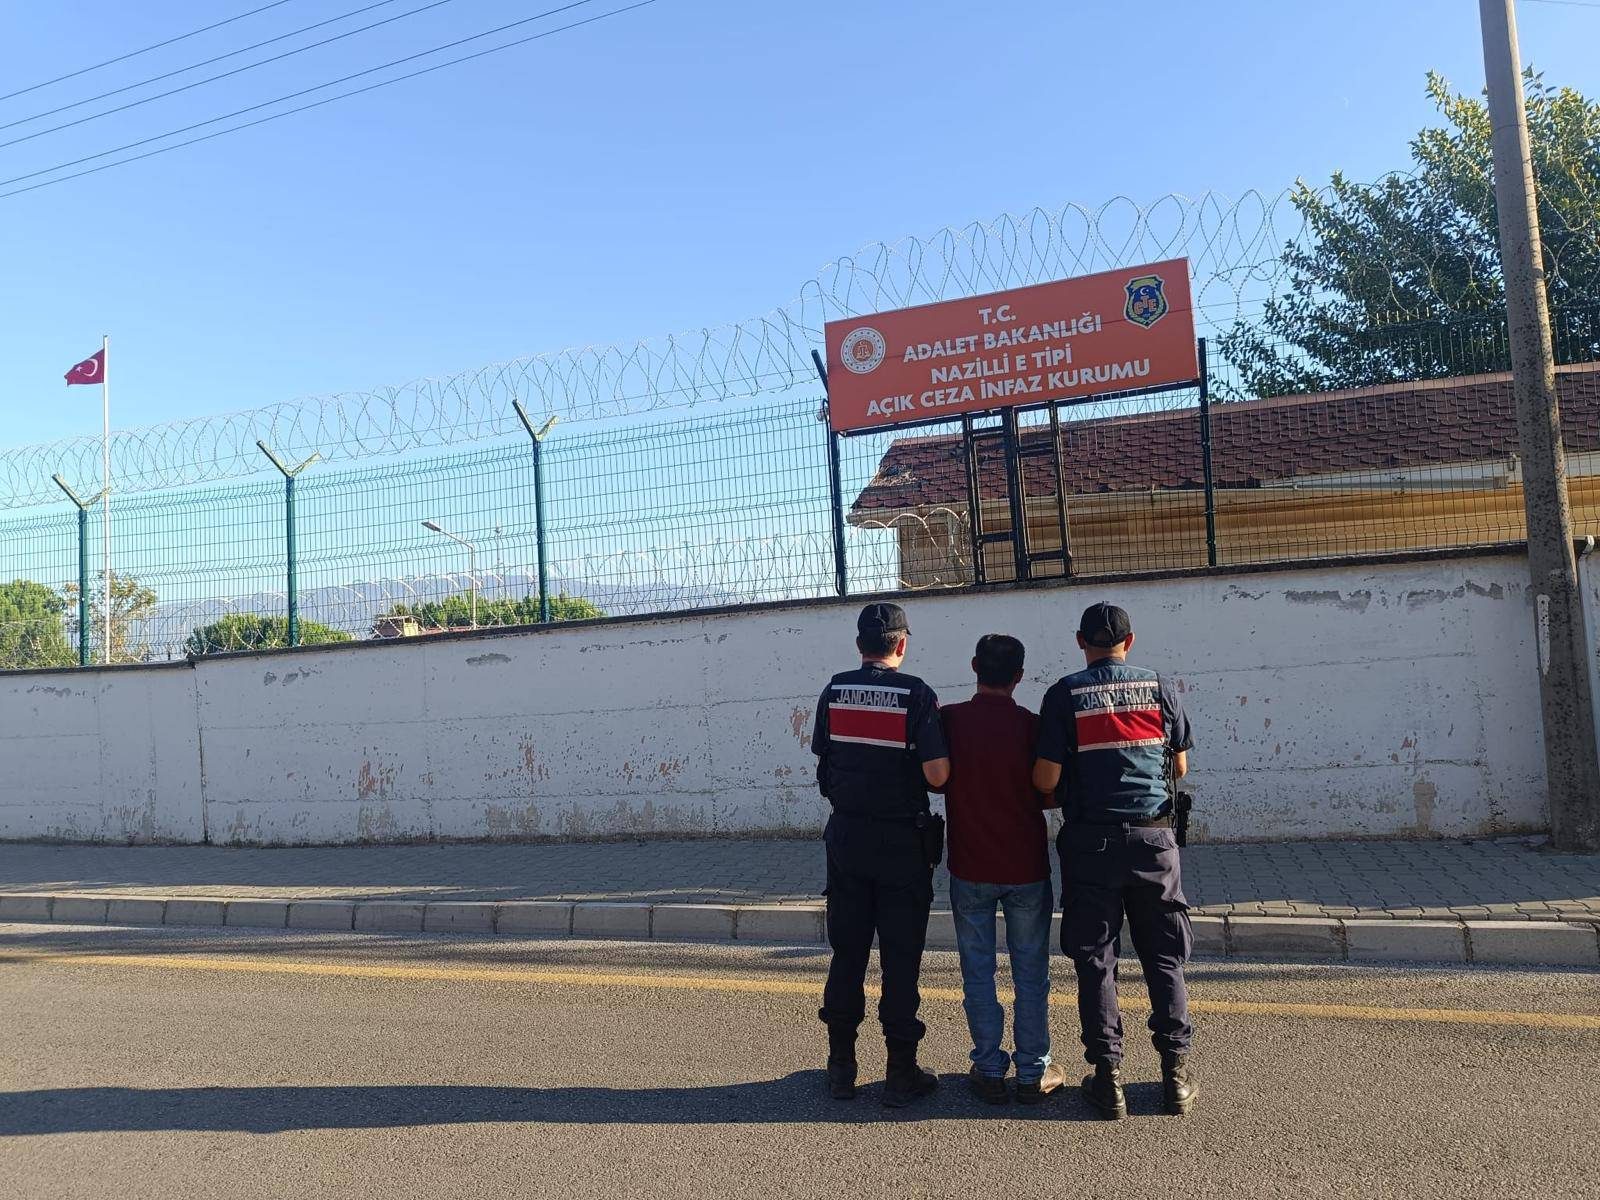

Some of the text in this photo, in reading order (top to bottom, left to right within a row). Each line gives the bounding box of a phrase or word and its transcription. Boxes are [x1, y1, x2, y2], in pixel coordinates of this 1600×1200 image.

[979, 305, 1017, 325] T.C.
[903, 312, 1102, 363] ADALET BAKANLIĞI
[931, 343, 1073, 384] NAZİLLİ E TİPİ
[866, 358, 1150, 417] AÇIK CEZA İNFAZ KURUMU
[836, 689, 899, 708] JANDARMA
[1082, 688, 1155, 710] JANDARMA
